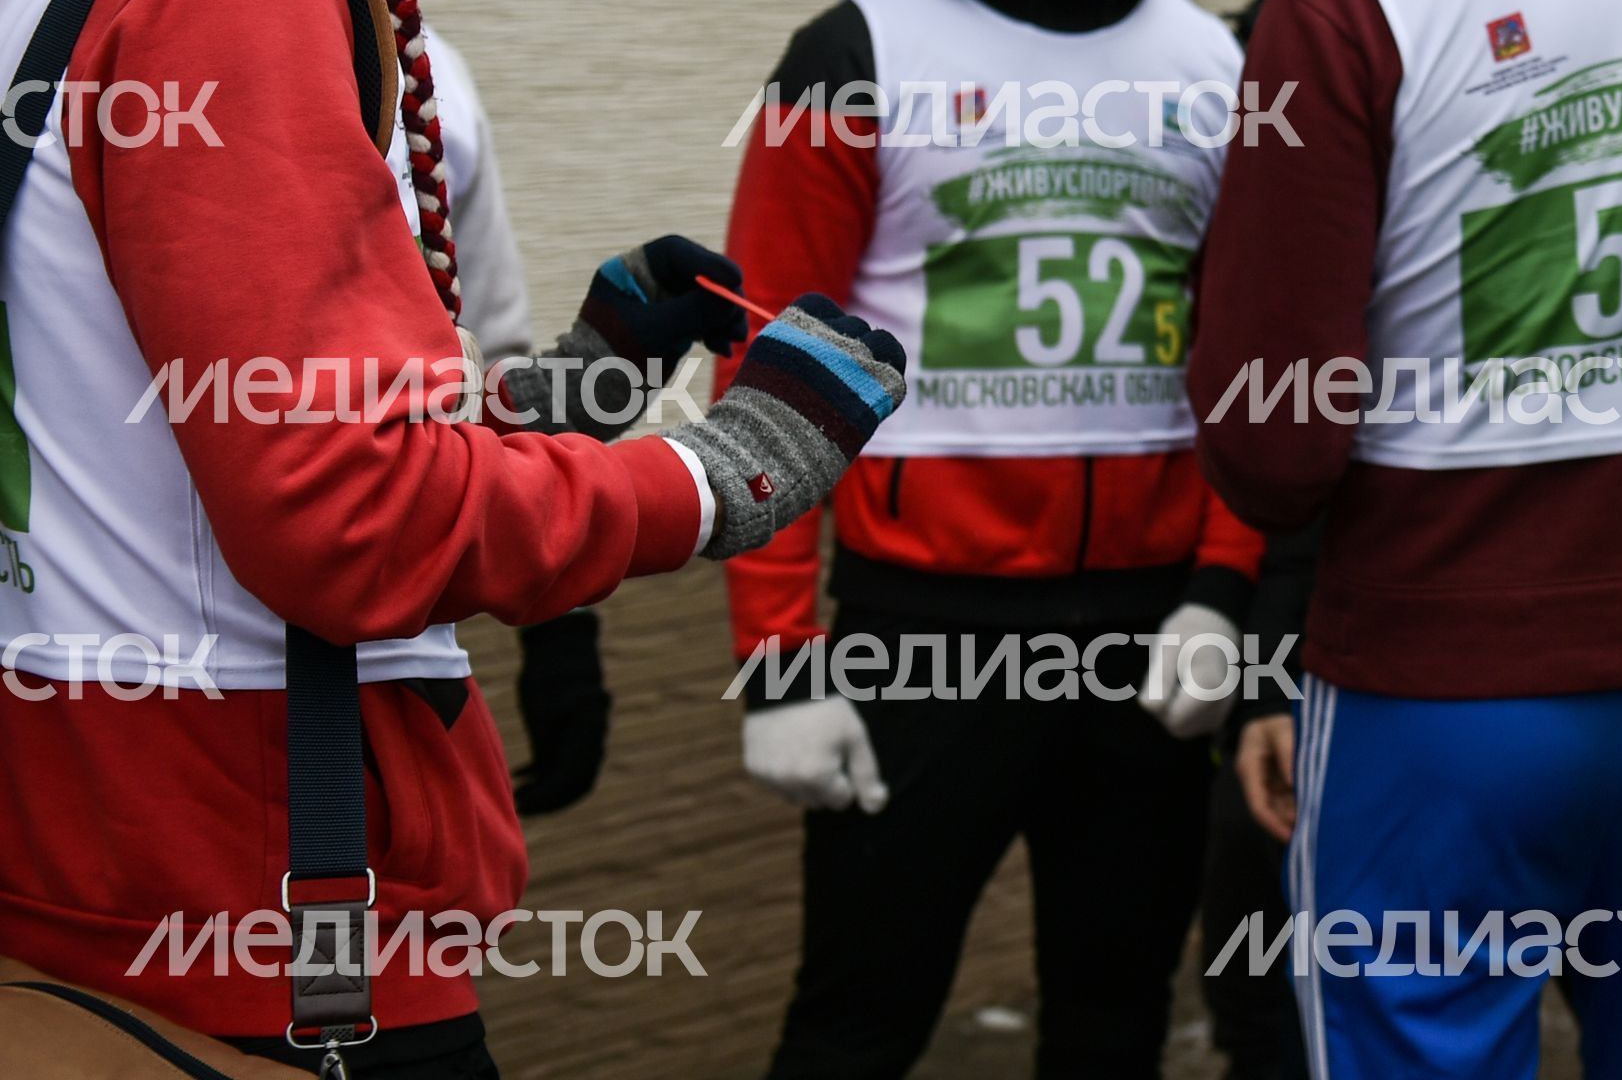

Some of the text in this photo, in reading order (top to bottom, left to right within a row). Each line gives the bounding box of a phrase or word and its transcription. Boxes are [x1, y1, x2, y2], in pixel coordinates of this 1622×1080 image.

[1015, 236, 1180, 366] 52 5
[916, 370, 1115, 409] МОСКОВСКАЯ
